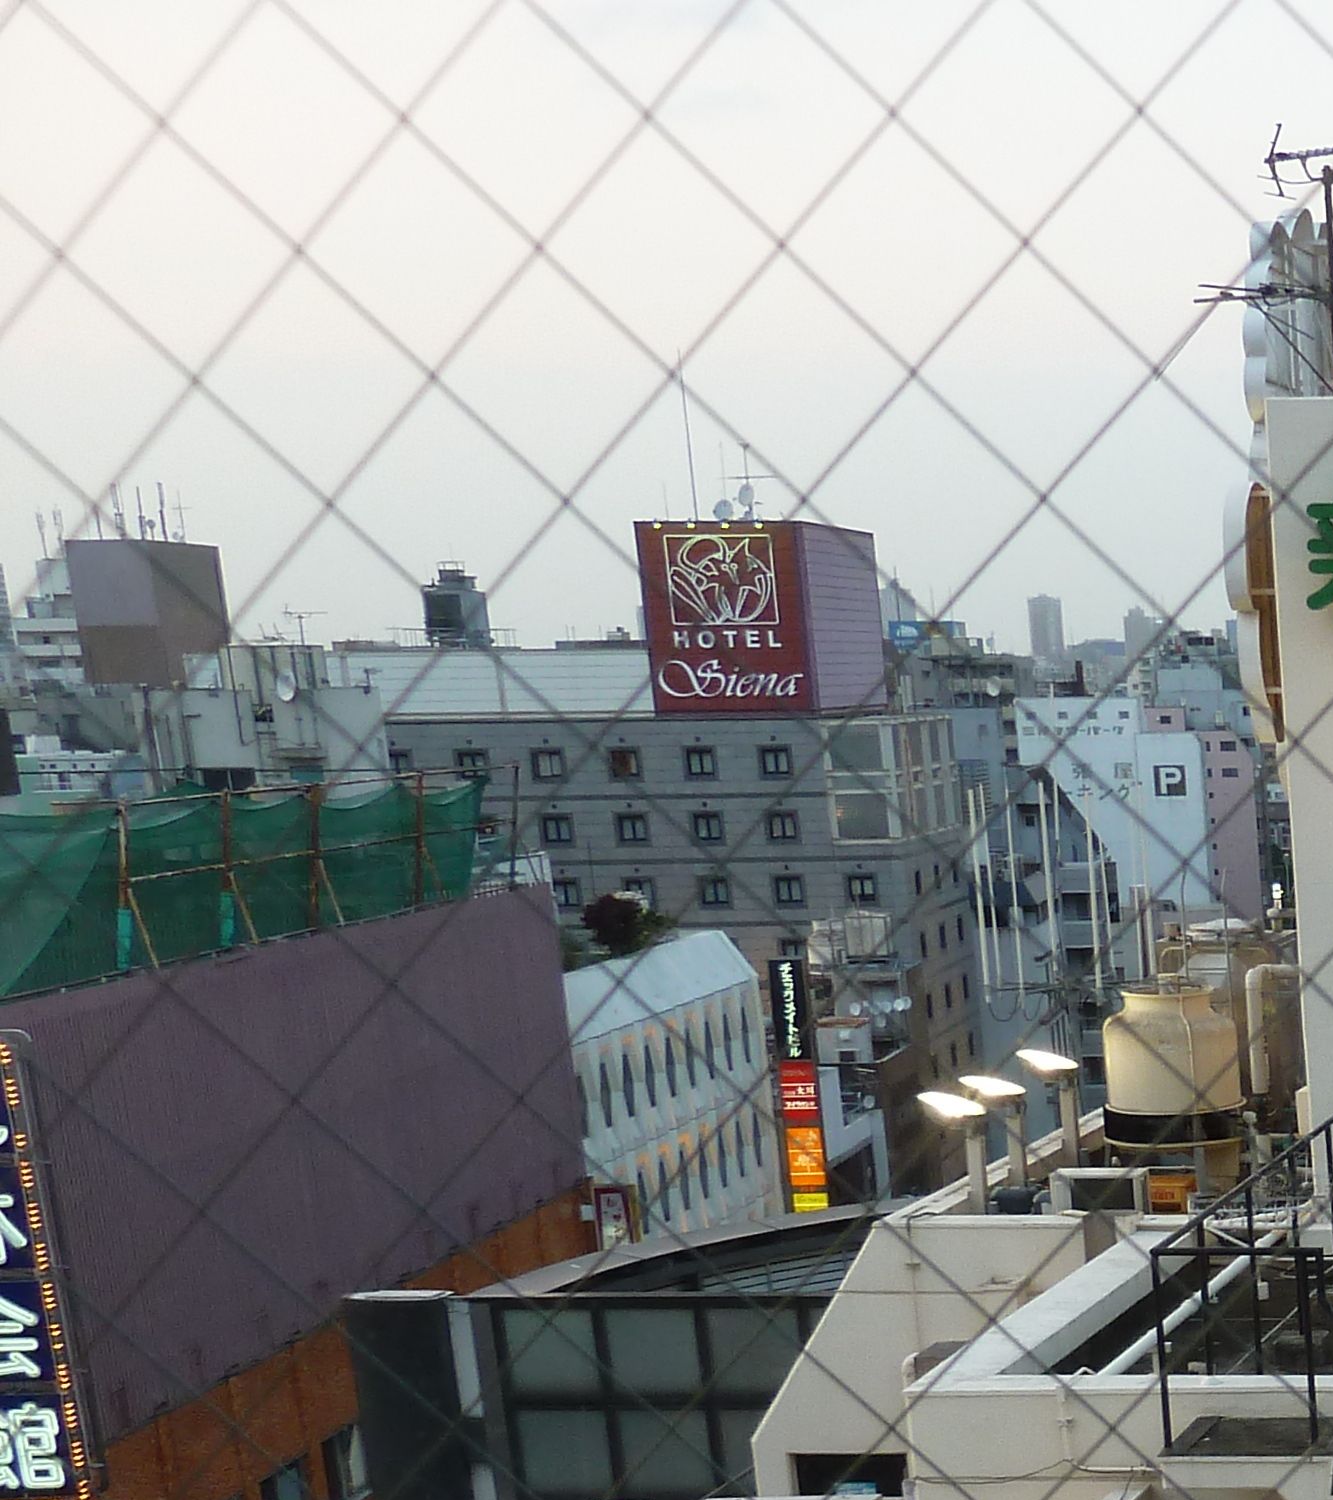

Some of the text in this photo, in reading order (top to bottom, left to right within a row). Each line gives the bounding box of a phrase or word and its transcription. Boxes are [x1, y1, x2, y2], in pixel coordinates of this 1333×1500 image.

[672, 630, 783, 649] HOTEL
[658, 659, 804, 698] Siena
[1159, 767, 1182, 795] P
